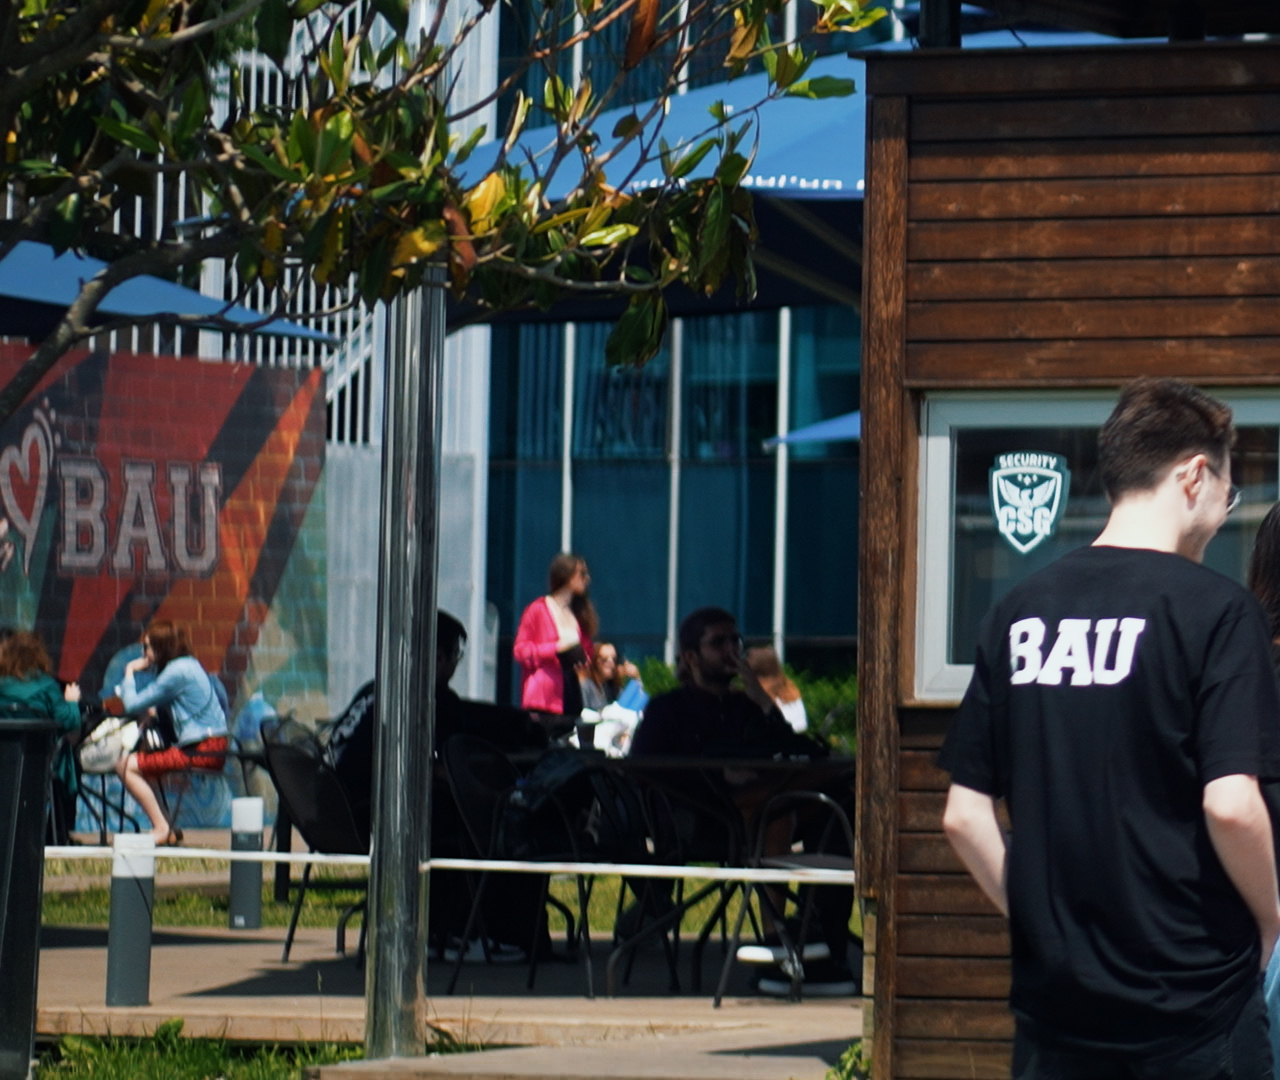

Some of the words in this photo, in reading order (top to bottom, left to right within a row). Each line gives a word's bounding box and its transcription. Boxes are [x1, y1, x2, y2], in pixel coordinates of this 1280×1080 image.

[998, 453, 1057, 469] SECURITY
[57, 454, 222, 578] BAU
[998, 505, 1051, 535] CSG
[1008, 617, 1146, 686] BAU
